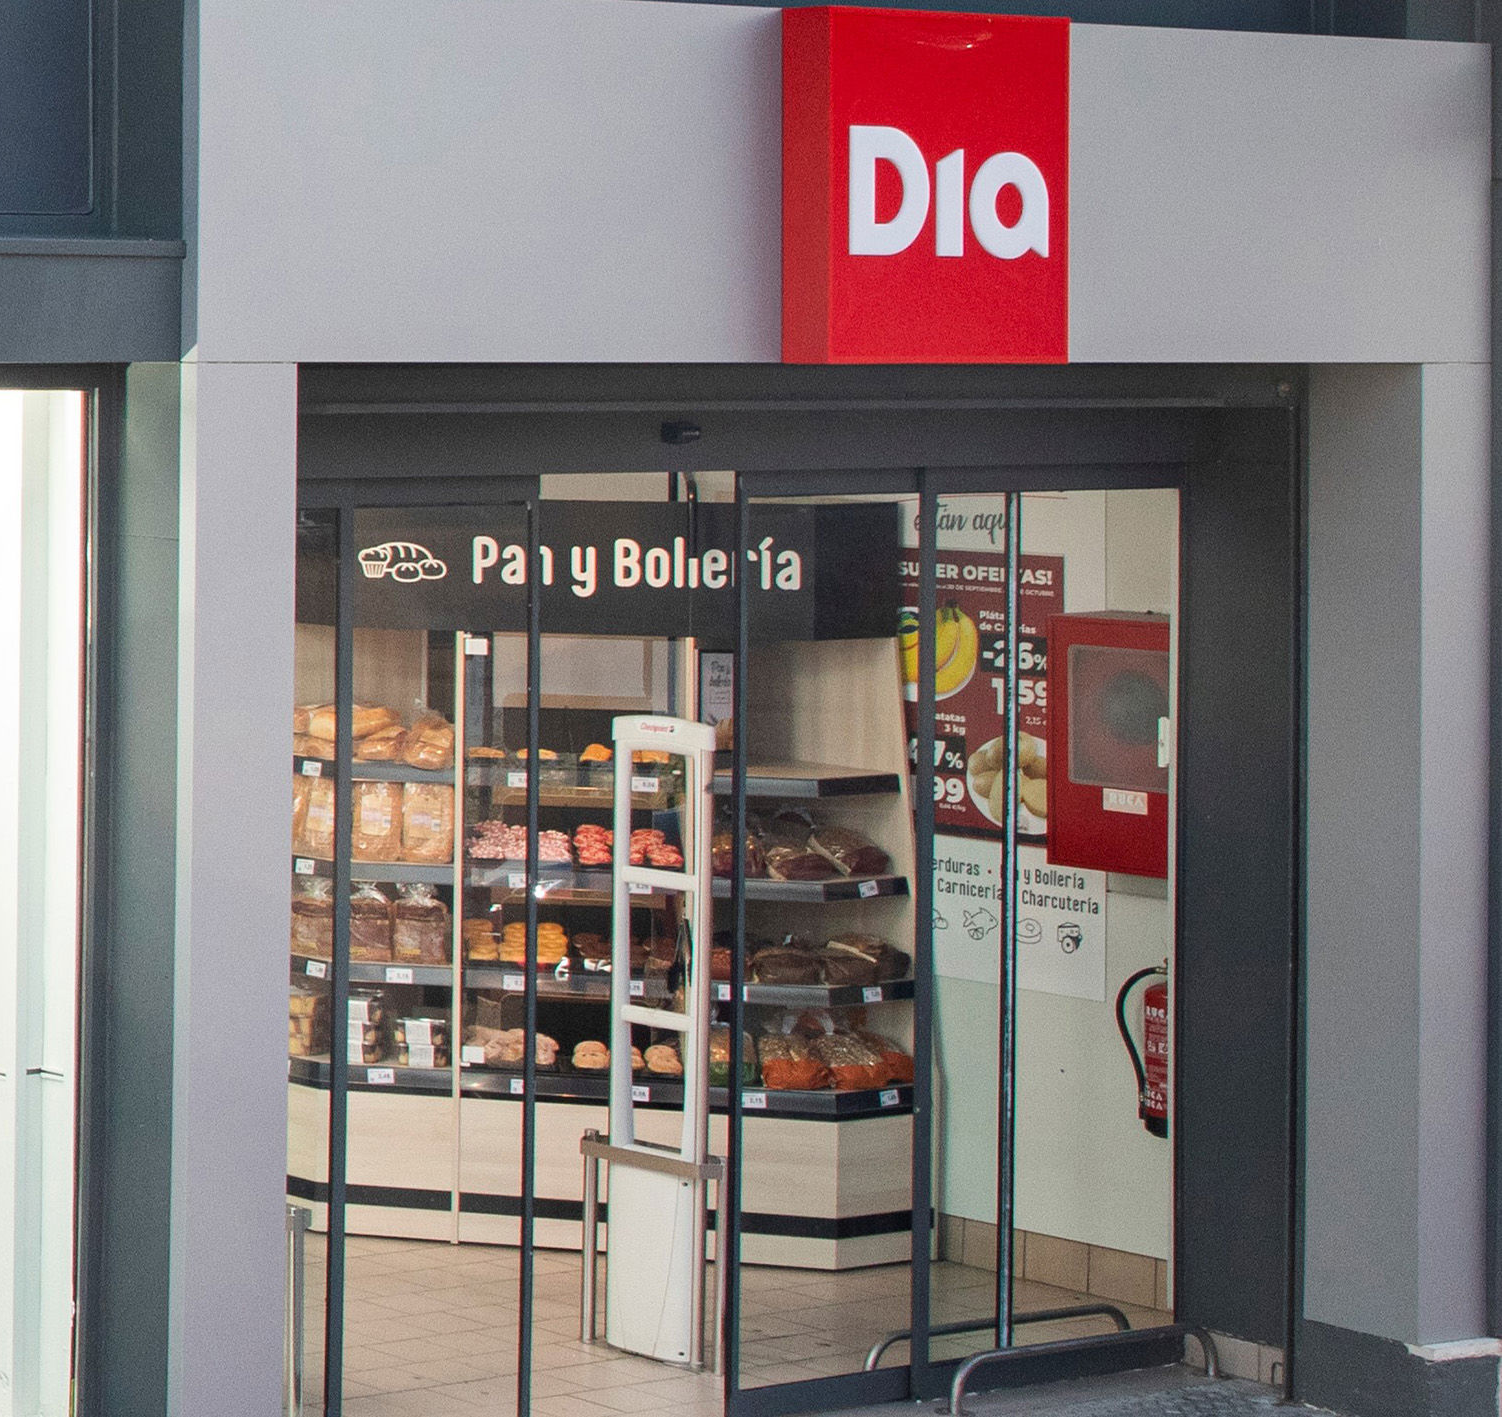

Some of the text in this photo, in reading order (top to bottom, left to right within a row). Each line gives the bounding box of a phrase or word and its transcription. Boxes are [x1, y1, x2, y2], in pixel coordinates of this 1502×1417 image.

[473, 535, 554, 586] Pan
[571, 546, 597, 598] y
[899, 560, 1053, 586] SUER OFEAS!
[979, 622, 992, 632] de
[935, 712, 966, 723] atatas
[933, 857, 1084, 890] erduras y Bollería
[937, 878, 1099, 915] Carnicería Charcutería
